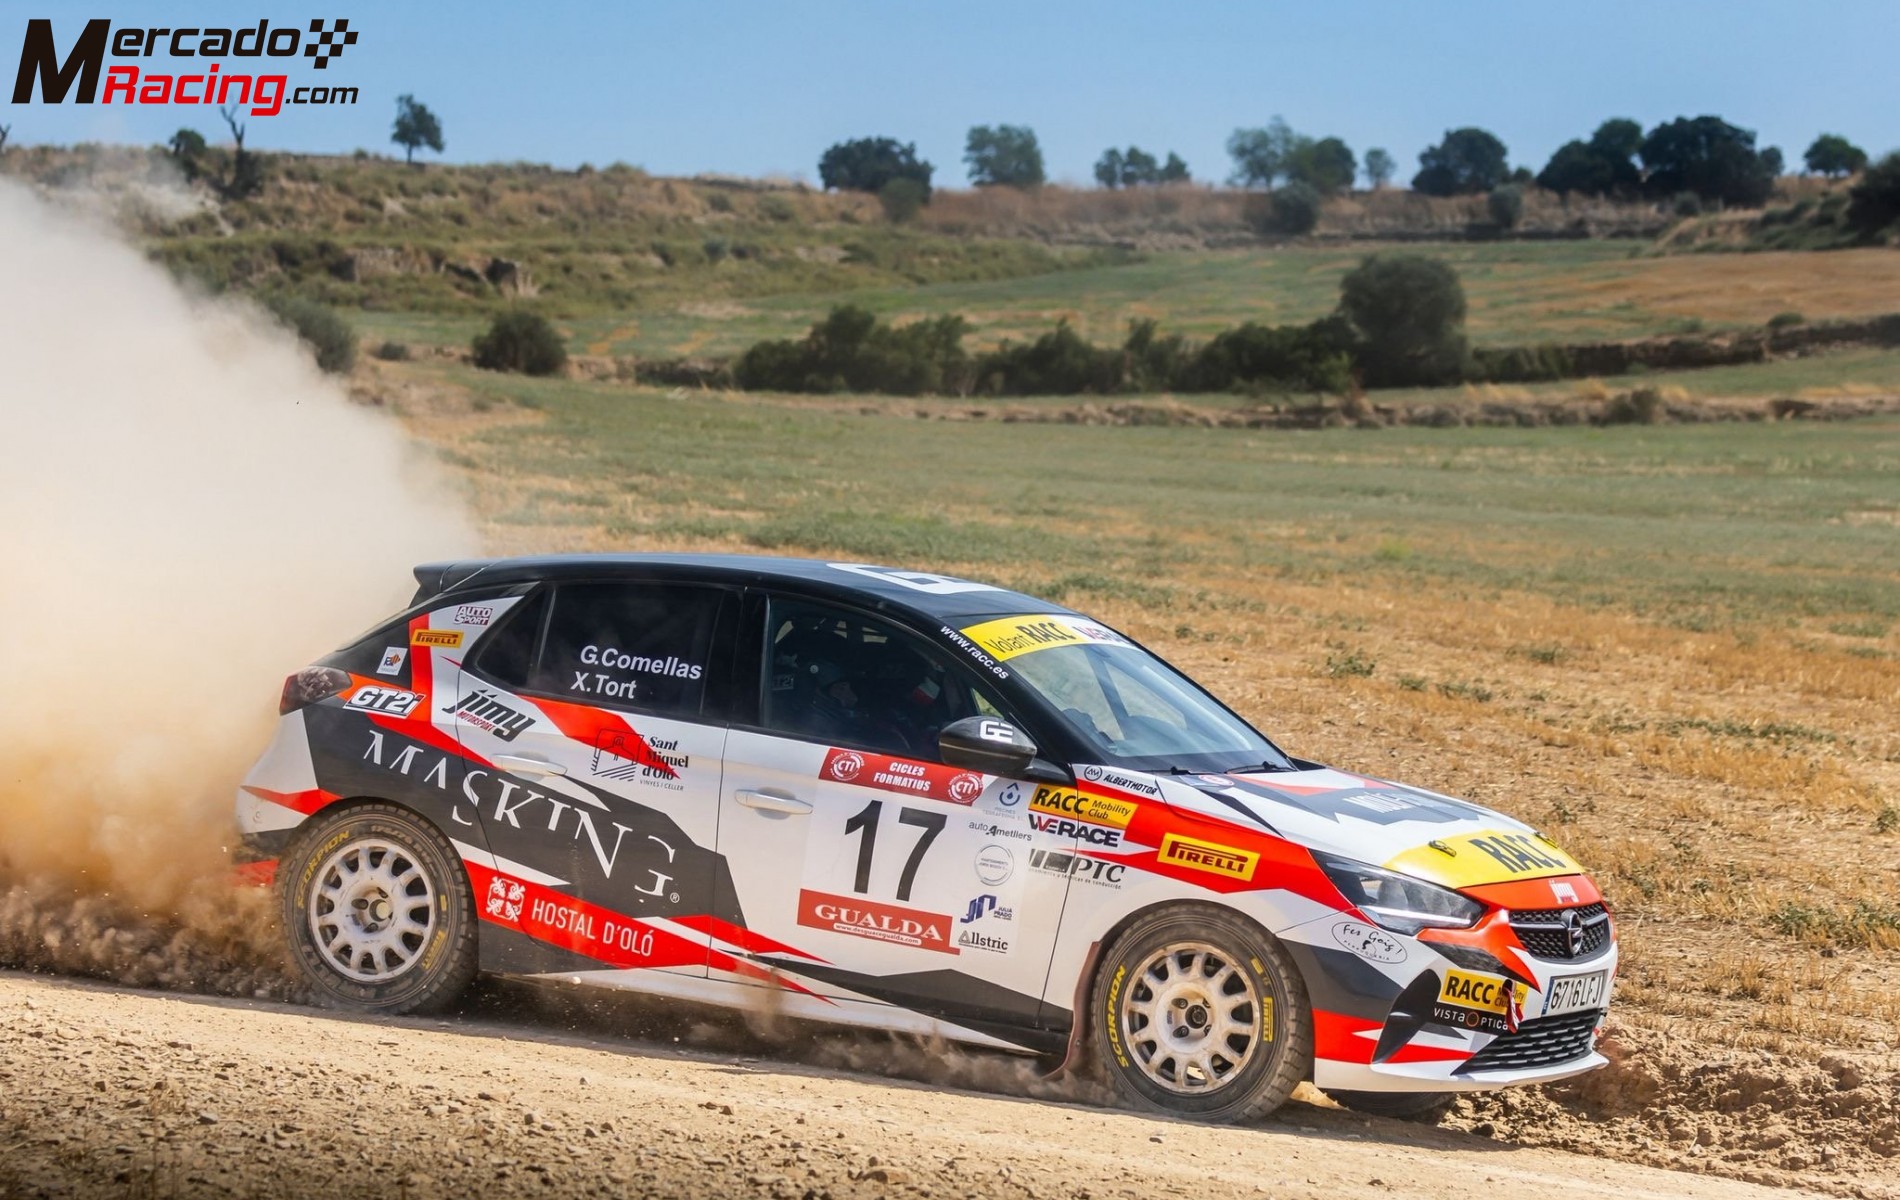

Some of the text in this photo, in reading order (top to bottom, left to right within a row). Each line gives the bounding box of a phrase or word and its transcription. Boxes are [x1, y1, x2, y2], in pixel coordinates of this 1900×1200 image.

[453, 615, 488, 625] SPORT
[458, 606, 492, 618] AUTO
[415, 631, 459, 645] PIRELLI
[984, 622, 1076, 653] Volant RACC
[580, 645, 702, 680] G.Comellas
[941, 626, 1009, 679] www.racc.es
[570, 671, 637, 699] X.Tort
[350, 687, 425, 715] GT2i
[442, 689, 536, 742] jimy
[457, 710, 496, 732] MOTORSPORT
[648, 736, 678, 751] Sant
[647, 750, 689, 768] Miquel
[838, 761, 855, 772] CTI
[889, 762, 926, 777] CICLES
[664, 782, 684, 791] CELLER
[873, 772, 931, 791] FORMATIUS
[956, 781, 973, 794] CTI
[1103, 774, 1158, 795] ALBERTMOTOR
[362, 730, 677, 898] MASKING
[1033, 788, 1089, 814] RACC
[1092, 800, 1131, 817] Mobility
[1088, 808, 1109, 820] Club
[844, 800, 947, 902] 17
[1166, 840, 1248, 873] PIRELLI
[1469, 834, 1567, 873] RACC
[1071, 857, 1126, 883] PTC
[531, 898, 655, 957] HOSTAL D'OLÓ
[815, 904, 943, 941] GUALDA
[1446, 976, 1494, 1004] RACC
[1104, 964, 1129, 1068] SCORPION
[1263, 996, 1274, 1042] PIRELLI
